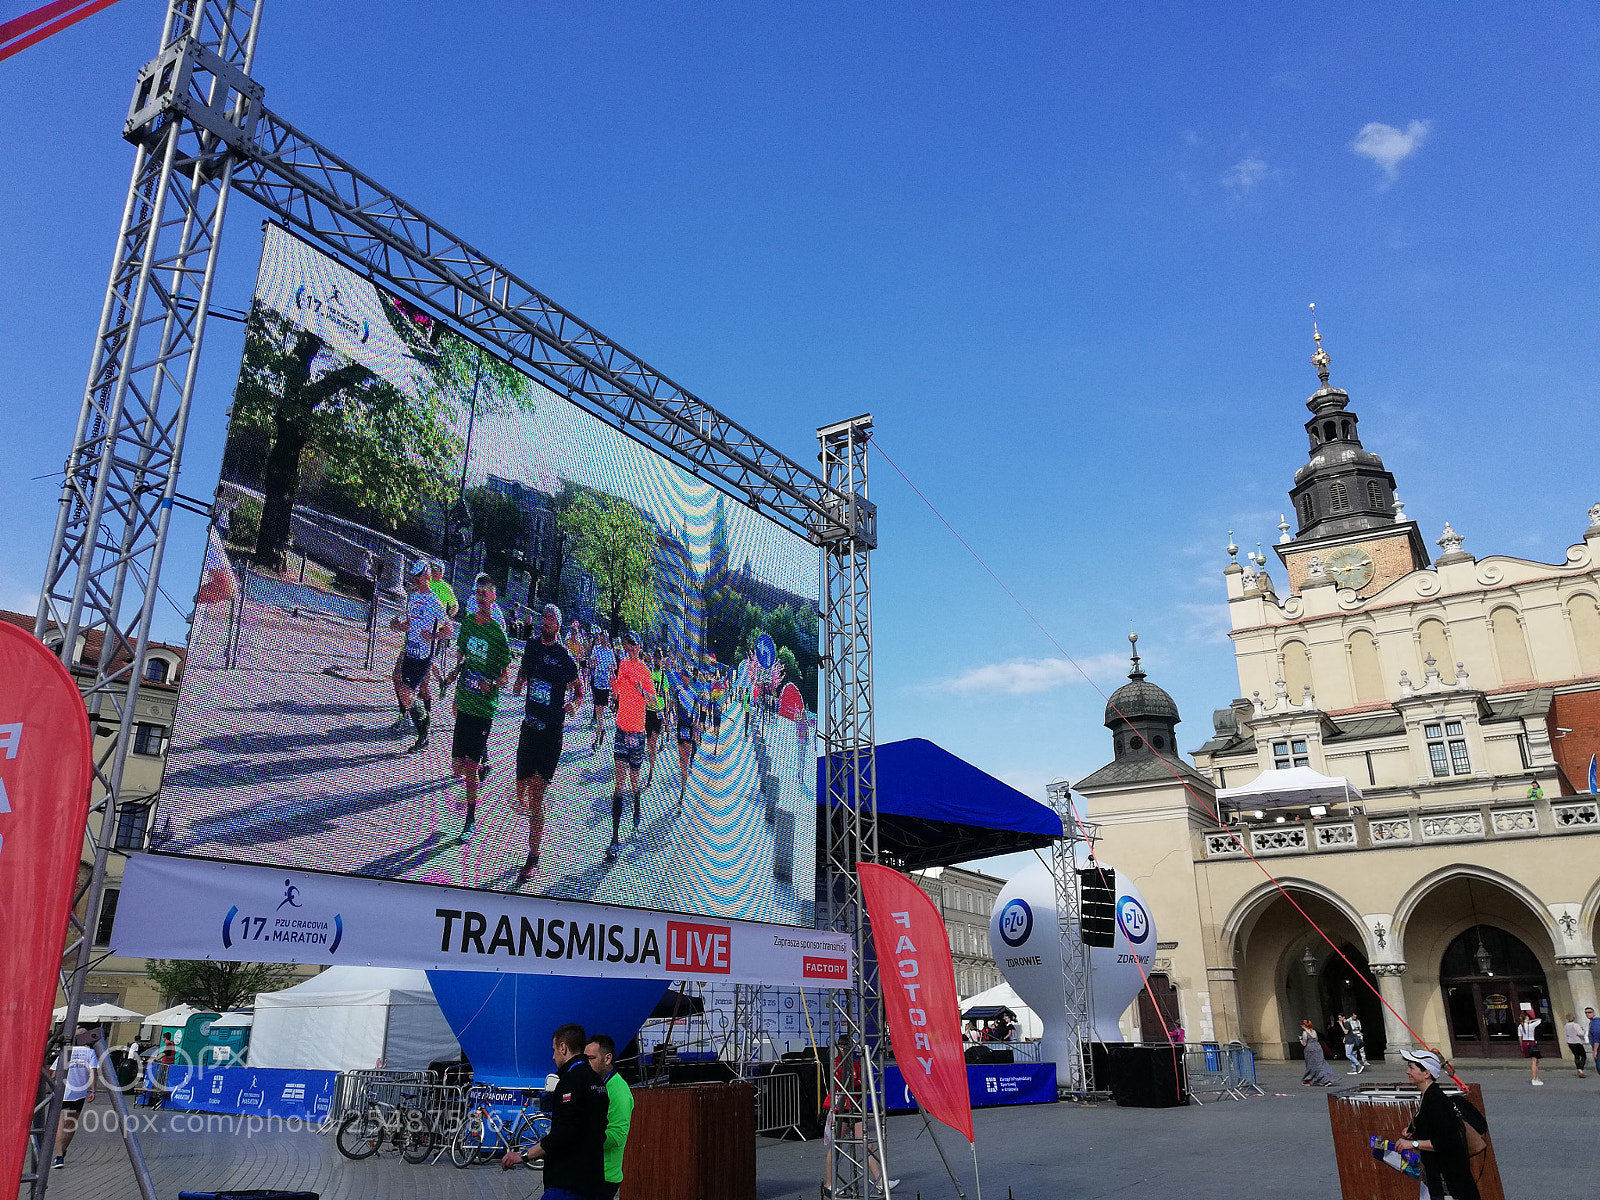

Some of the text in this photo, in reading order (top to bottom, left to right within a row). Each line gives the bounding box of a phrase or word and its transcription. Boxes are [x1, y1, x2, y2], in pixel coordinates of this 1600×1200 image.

[275, 919, 328, 930] PZU CRACOVIA
[1004, 911, 1024, 933] PZU
[1125, 908, 1144, 929] PZU
[241, 917, 269, 941] 17.
[273, 930, 328, 944] MARATON
[435, 908, 728, 968] TRANSMISJA LIVE
[774, 935, 800, 949] Zaprasza
[800, 940, 822, 950] sponsor
[1005, 955, 1042, 968] ZDROWIE
[1117, 954, 1150, 965] ZDROWIE
[806, 963, 845, 973] FACTORY
[784, 1041, 790, 1052] 1
